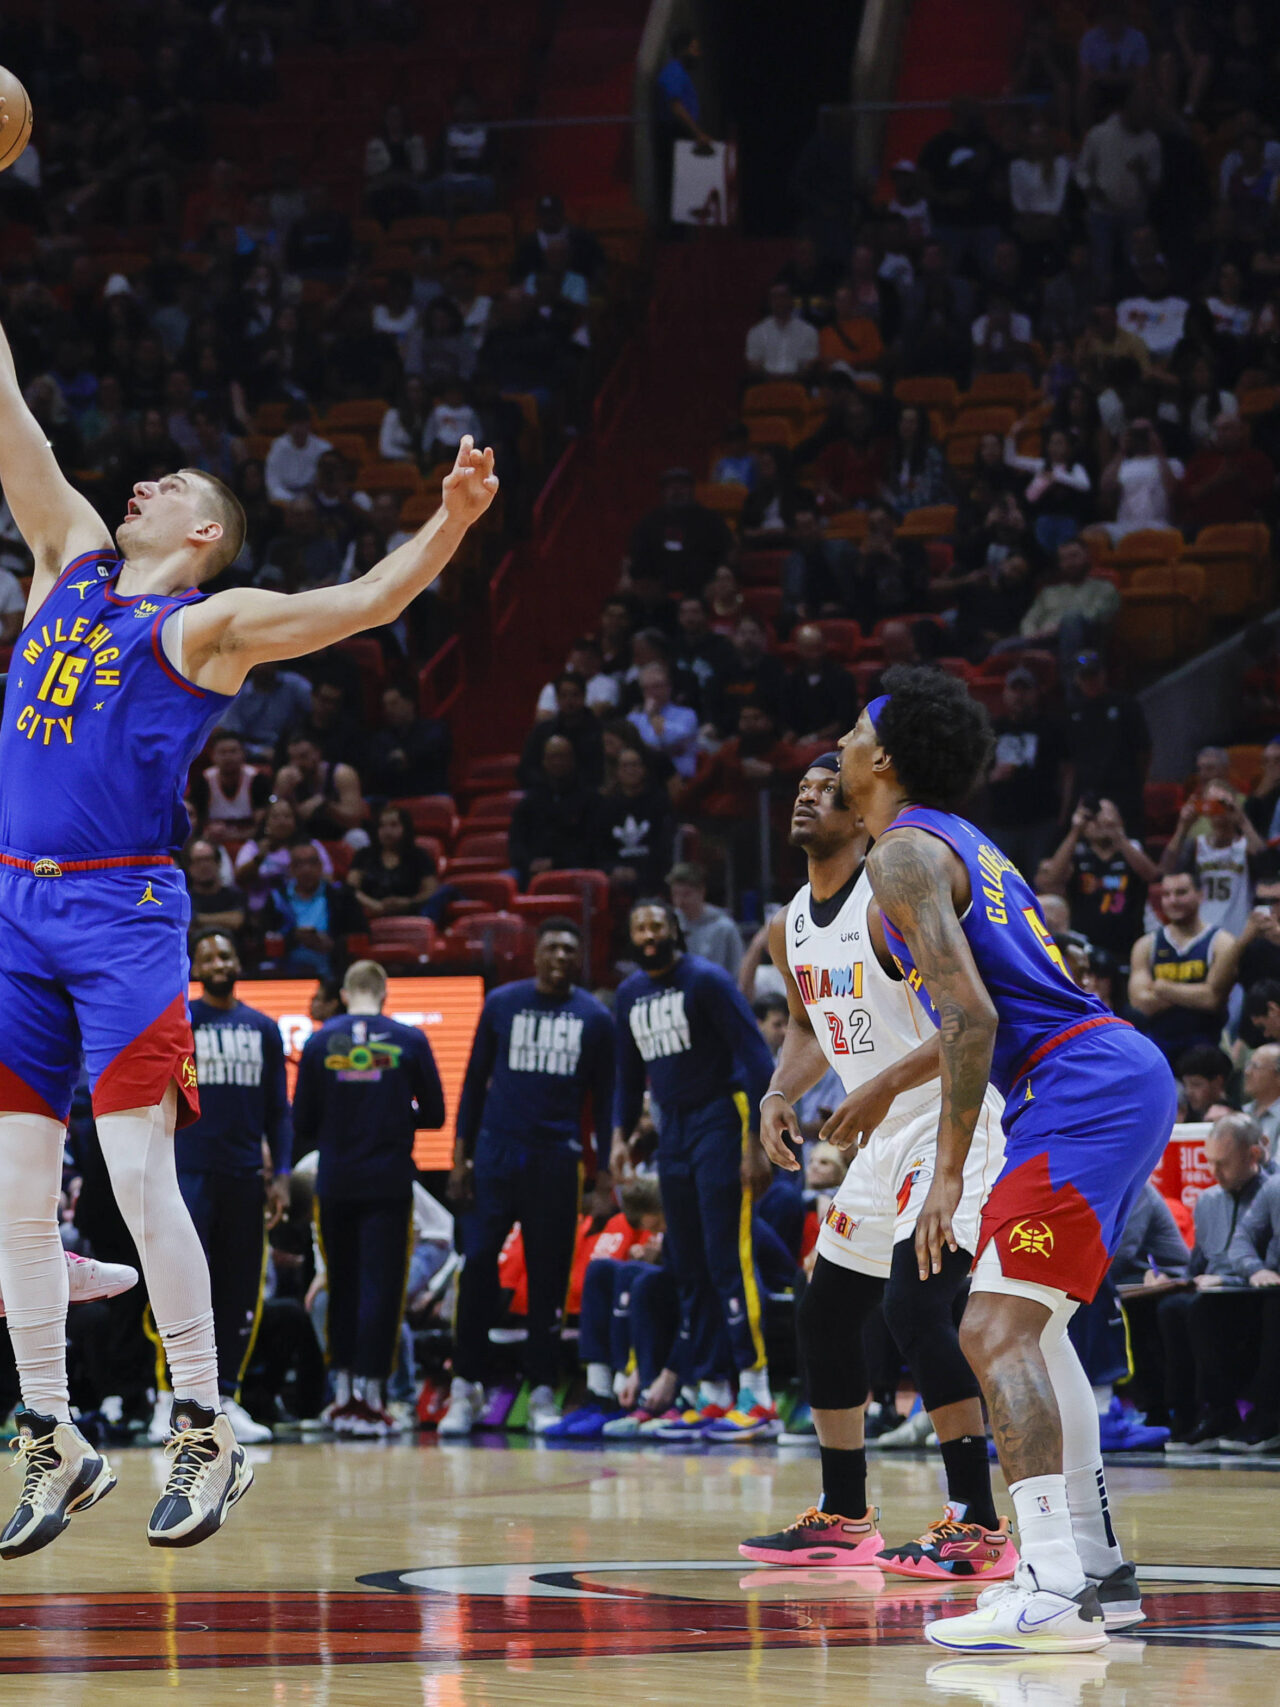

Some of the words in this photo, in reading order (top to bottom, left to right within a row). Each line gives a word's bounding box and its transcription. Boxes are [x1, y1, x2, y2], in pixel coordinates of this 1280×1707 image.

[37, 650, 88, 707] 15
[16, 705, 73, 745] CITY
[1206, 877, 1232, 900] 15
[795, 914, 805, 933] 6
[795, 961, 863, 1005] MIAMI
[509, 1014, 584, 1049] BLACK
[824, 1008, 874, 1054] 22
